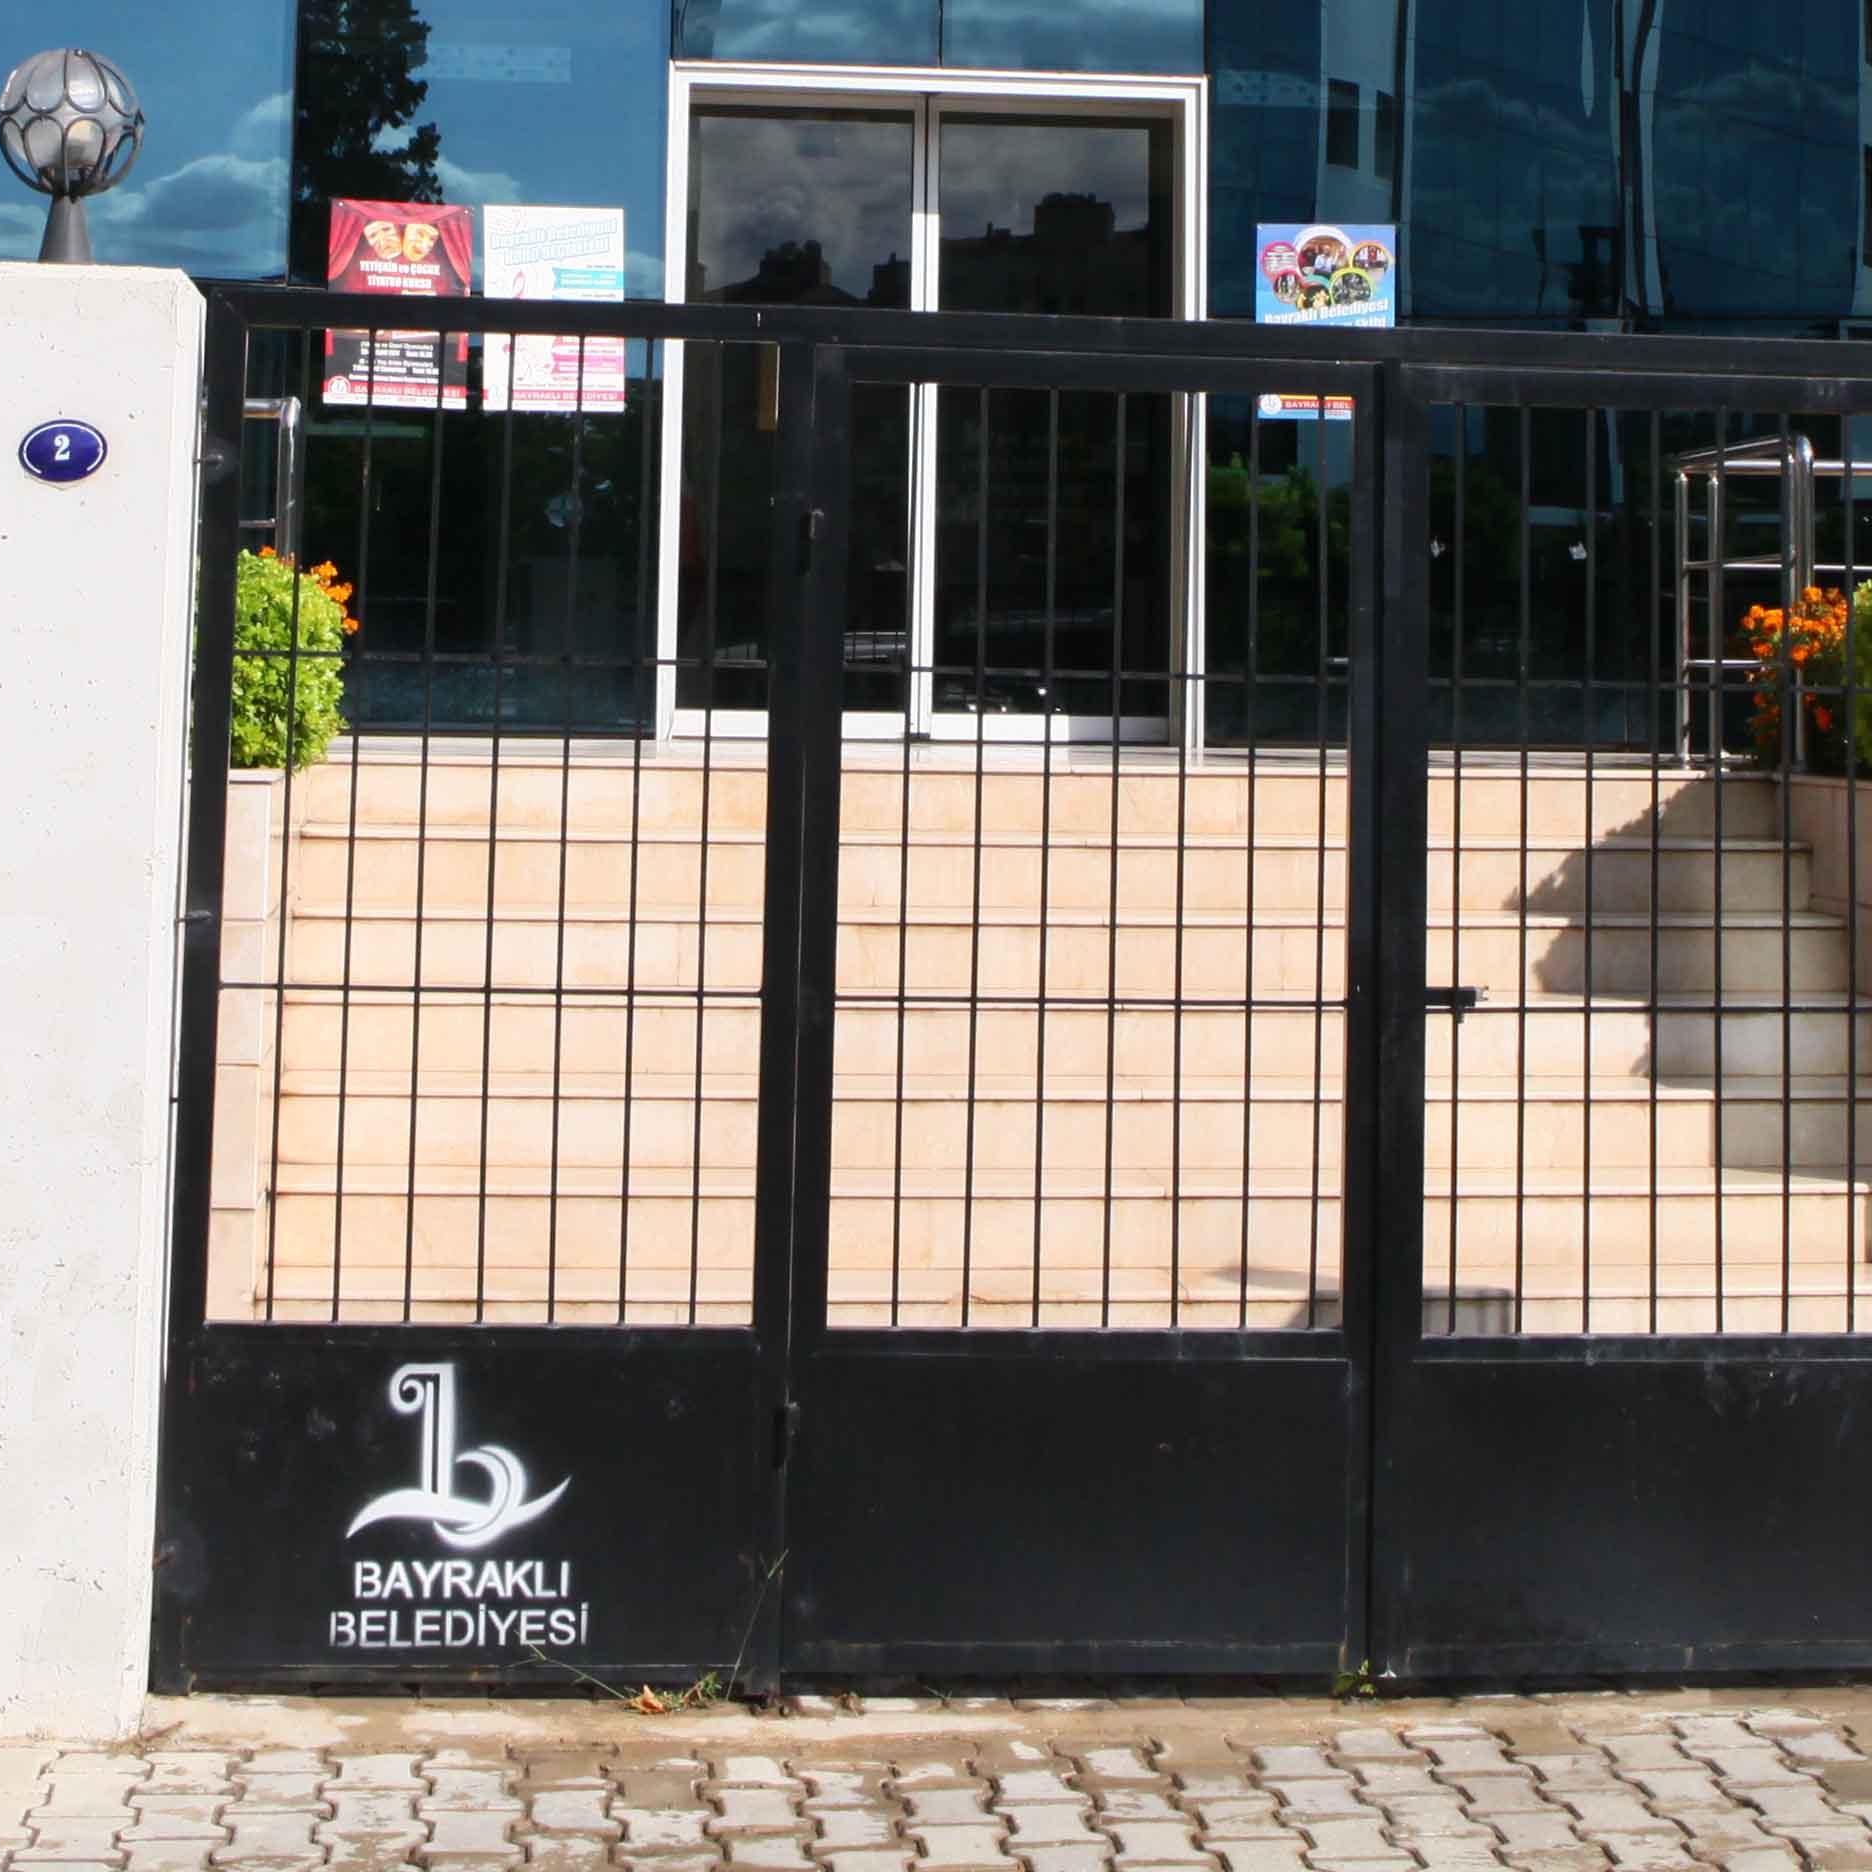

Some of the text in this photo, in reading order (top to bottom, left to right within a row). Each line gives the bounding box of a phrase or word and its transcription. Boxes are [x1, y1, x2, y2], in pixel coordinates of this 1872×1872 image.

[53, 433, 71, 461] 2
[353, 1560, 570, 1599] BAYRAKLI
[329, 1601, 590, 1648] BELEDİYESİ
